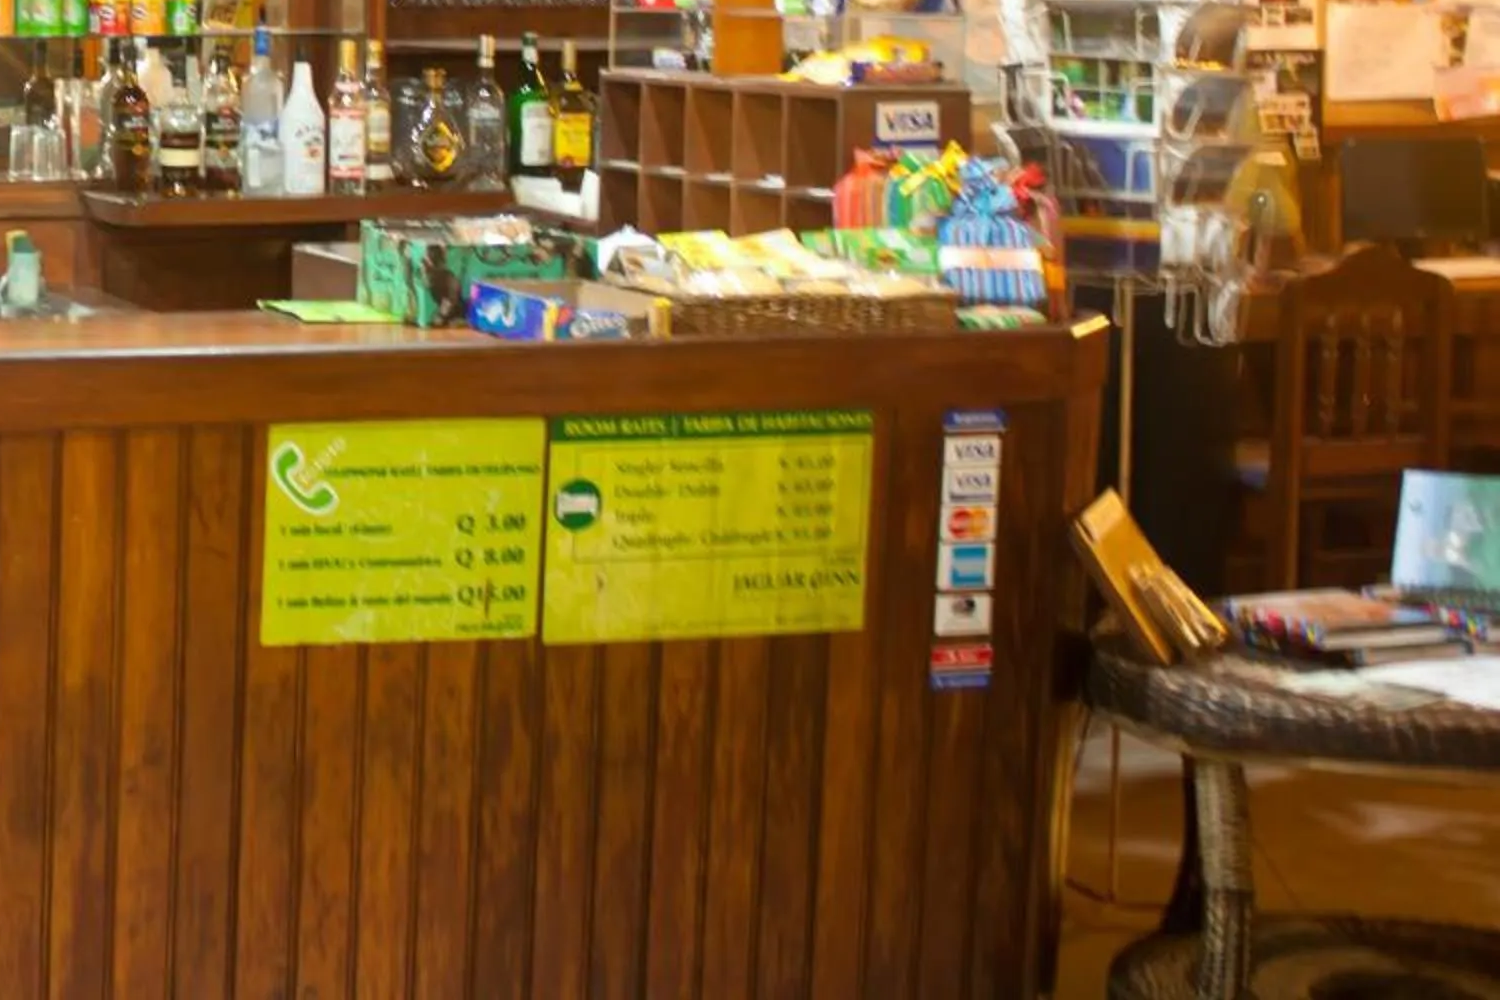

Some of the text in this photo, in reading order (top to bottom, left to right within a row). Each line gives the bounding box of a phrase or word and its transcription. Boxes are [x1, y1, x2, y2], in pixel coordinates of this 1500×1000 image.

[884, 110, 934, 132] VISA
[954, 442, 996, 460] VISA
[955, 472, 992, 489] VISA
